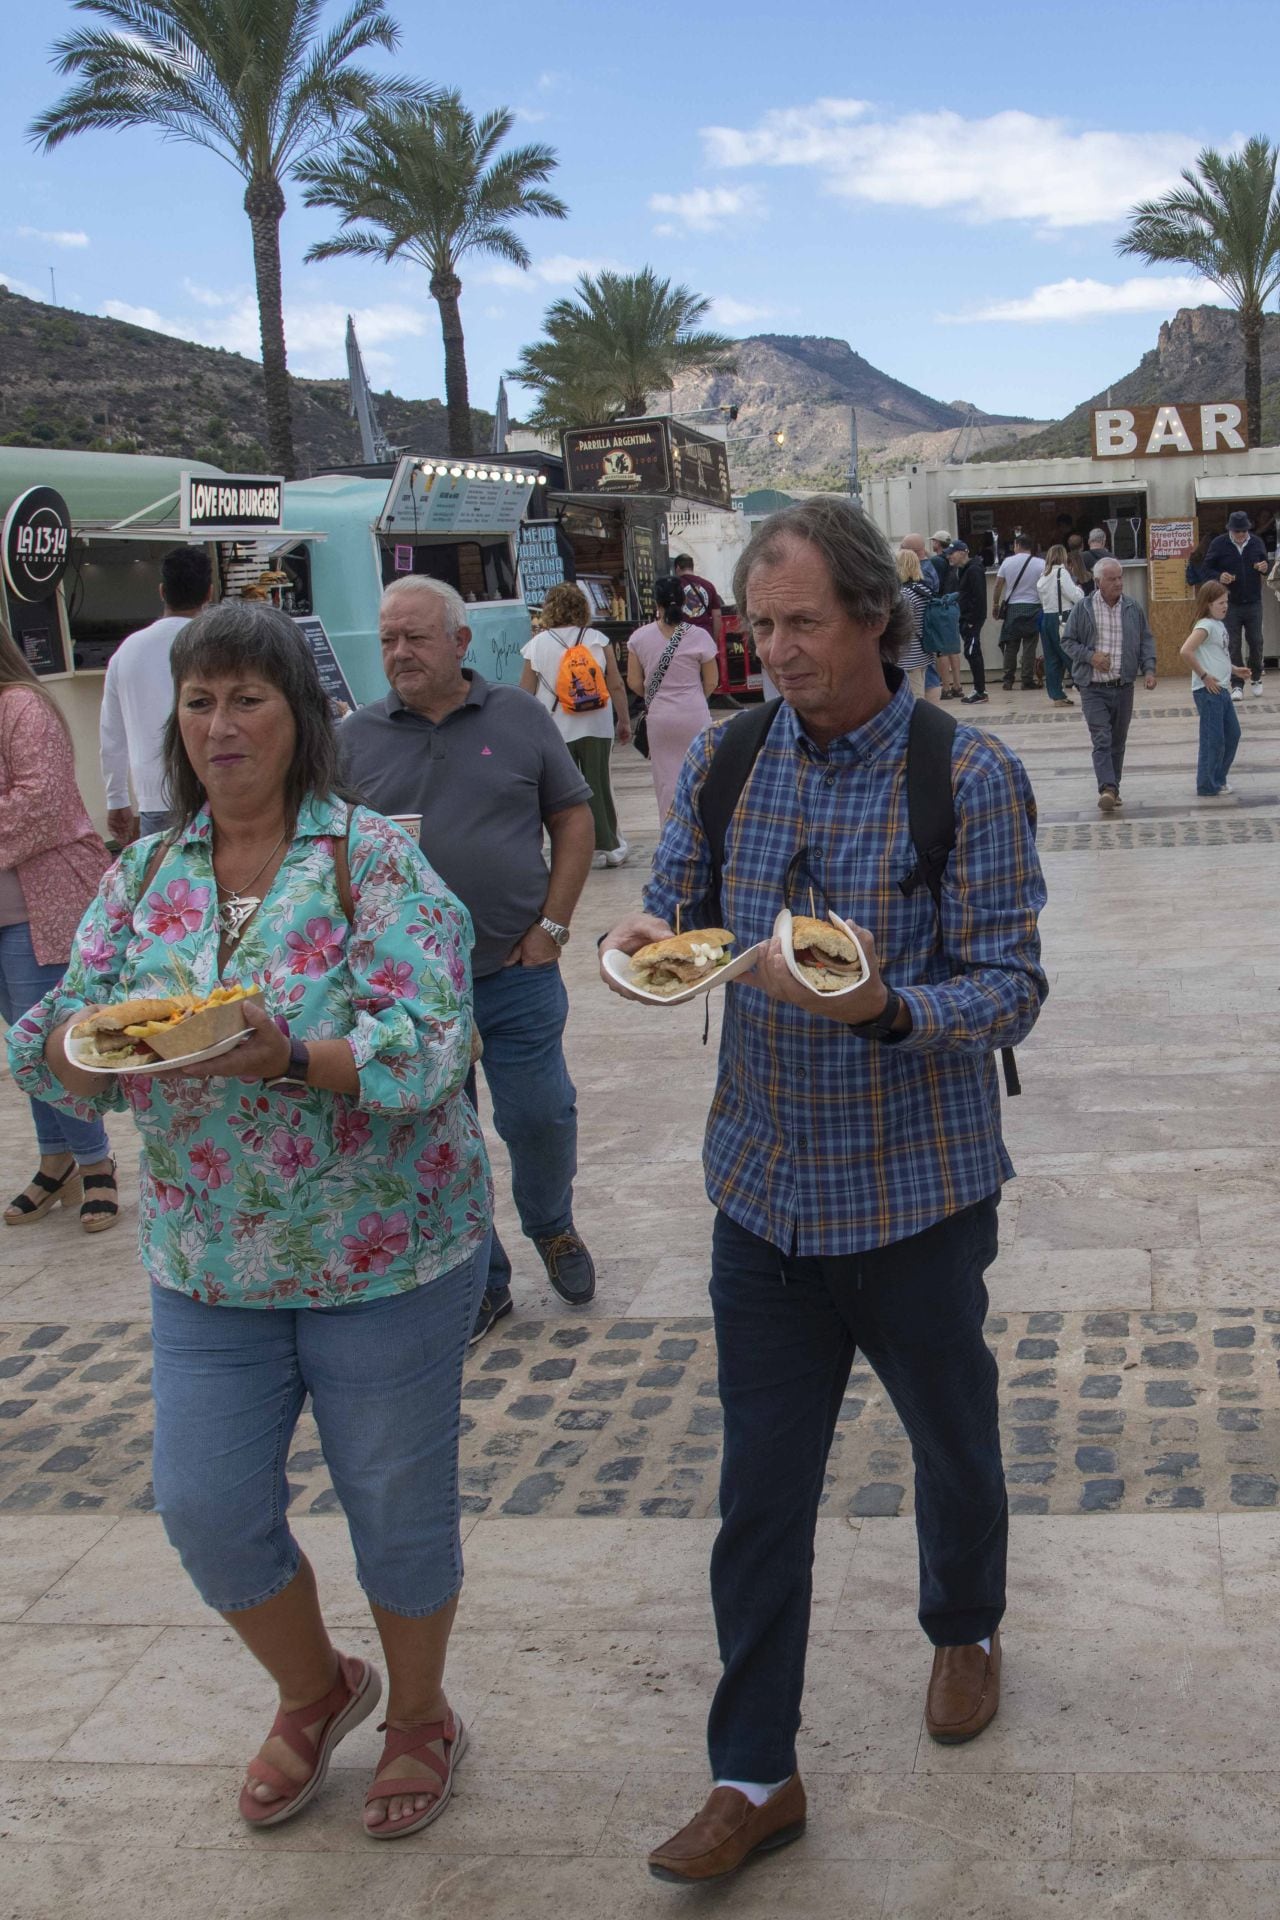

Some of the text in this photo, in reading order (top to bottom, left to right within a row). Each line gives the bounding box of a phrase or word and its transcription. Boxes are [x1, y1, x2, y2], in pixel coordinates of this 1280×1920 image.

[1095, 403, 1245, 456] BAR
[579, 438, 611, 451] PARRILLA
[613, 433, 651, 448] ARGENTINA
[191, 483, 279, 519] LOVE FOR BURGERS
[17, 525, 34, 554] LA
[522, 526, 556, 543] MEJOR
[1152, 530, 1191, 539] Streetfood
[1152, 538, 1192, 548] Market
[525, 591, 545, 604] 202
